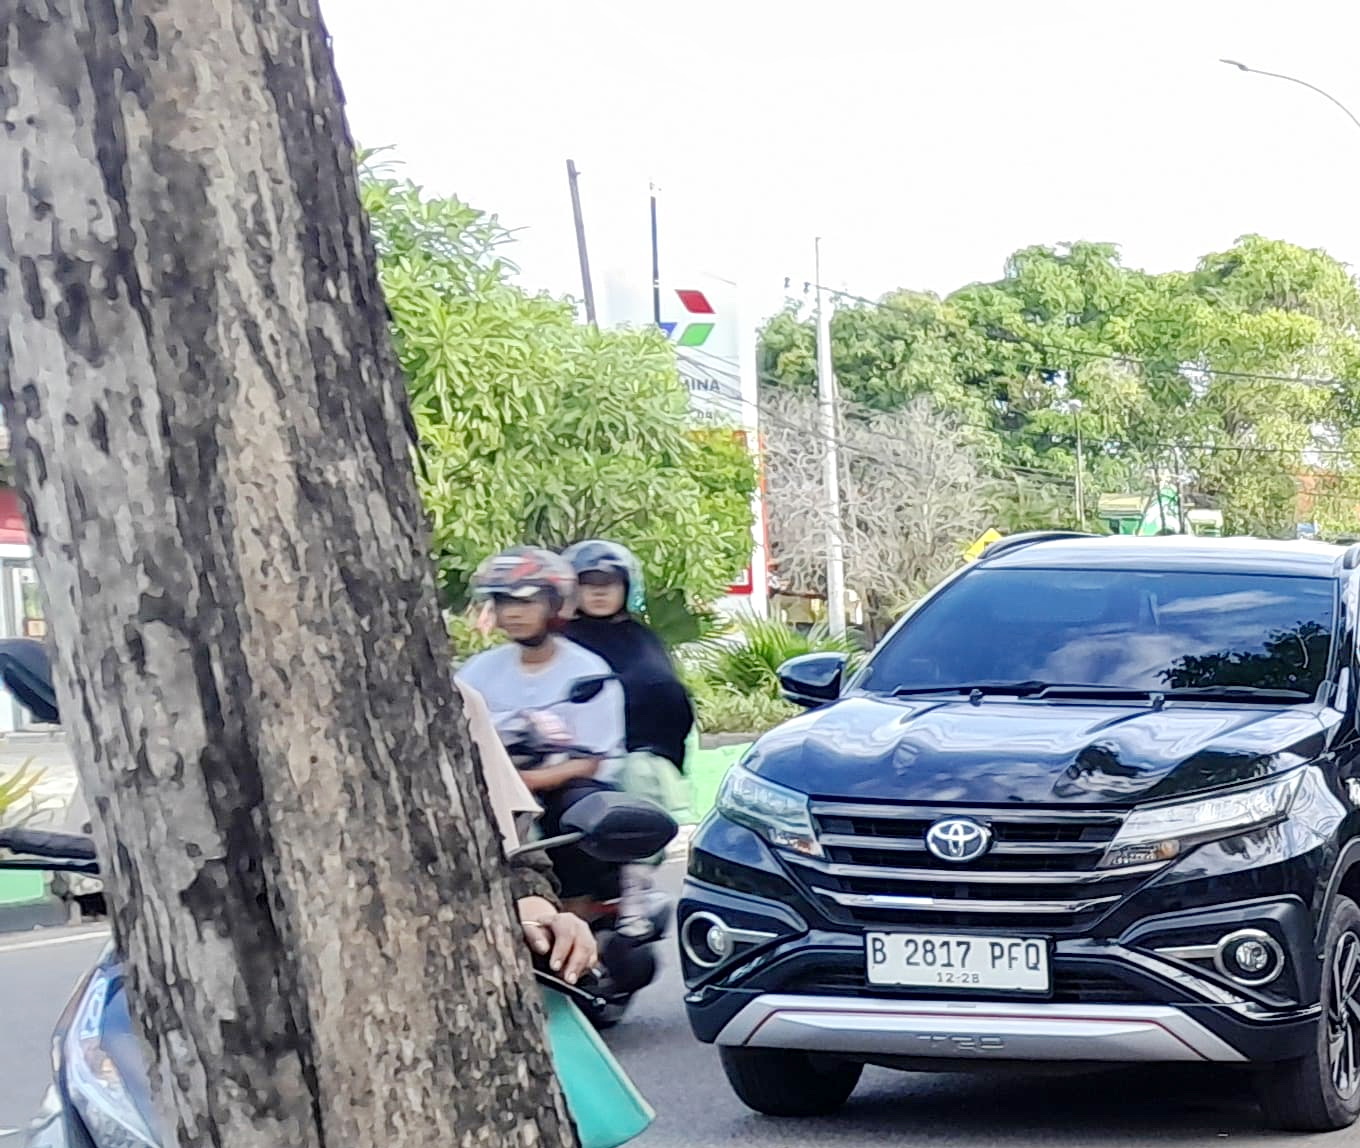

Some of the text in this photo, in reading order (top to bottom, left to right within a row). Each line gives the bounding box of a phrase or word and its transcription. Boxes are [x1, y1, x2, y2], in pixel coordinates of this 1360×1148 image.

[872, 937, 1041, 971] B 2817 PFQ
